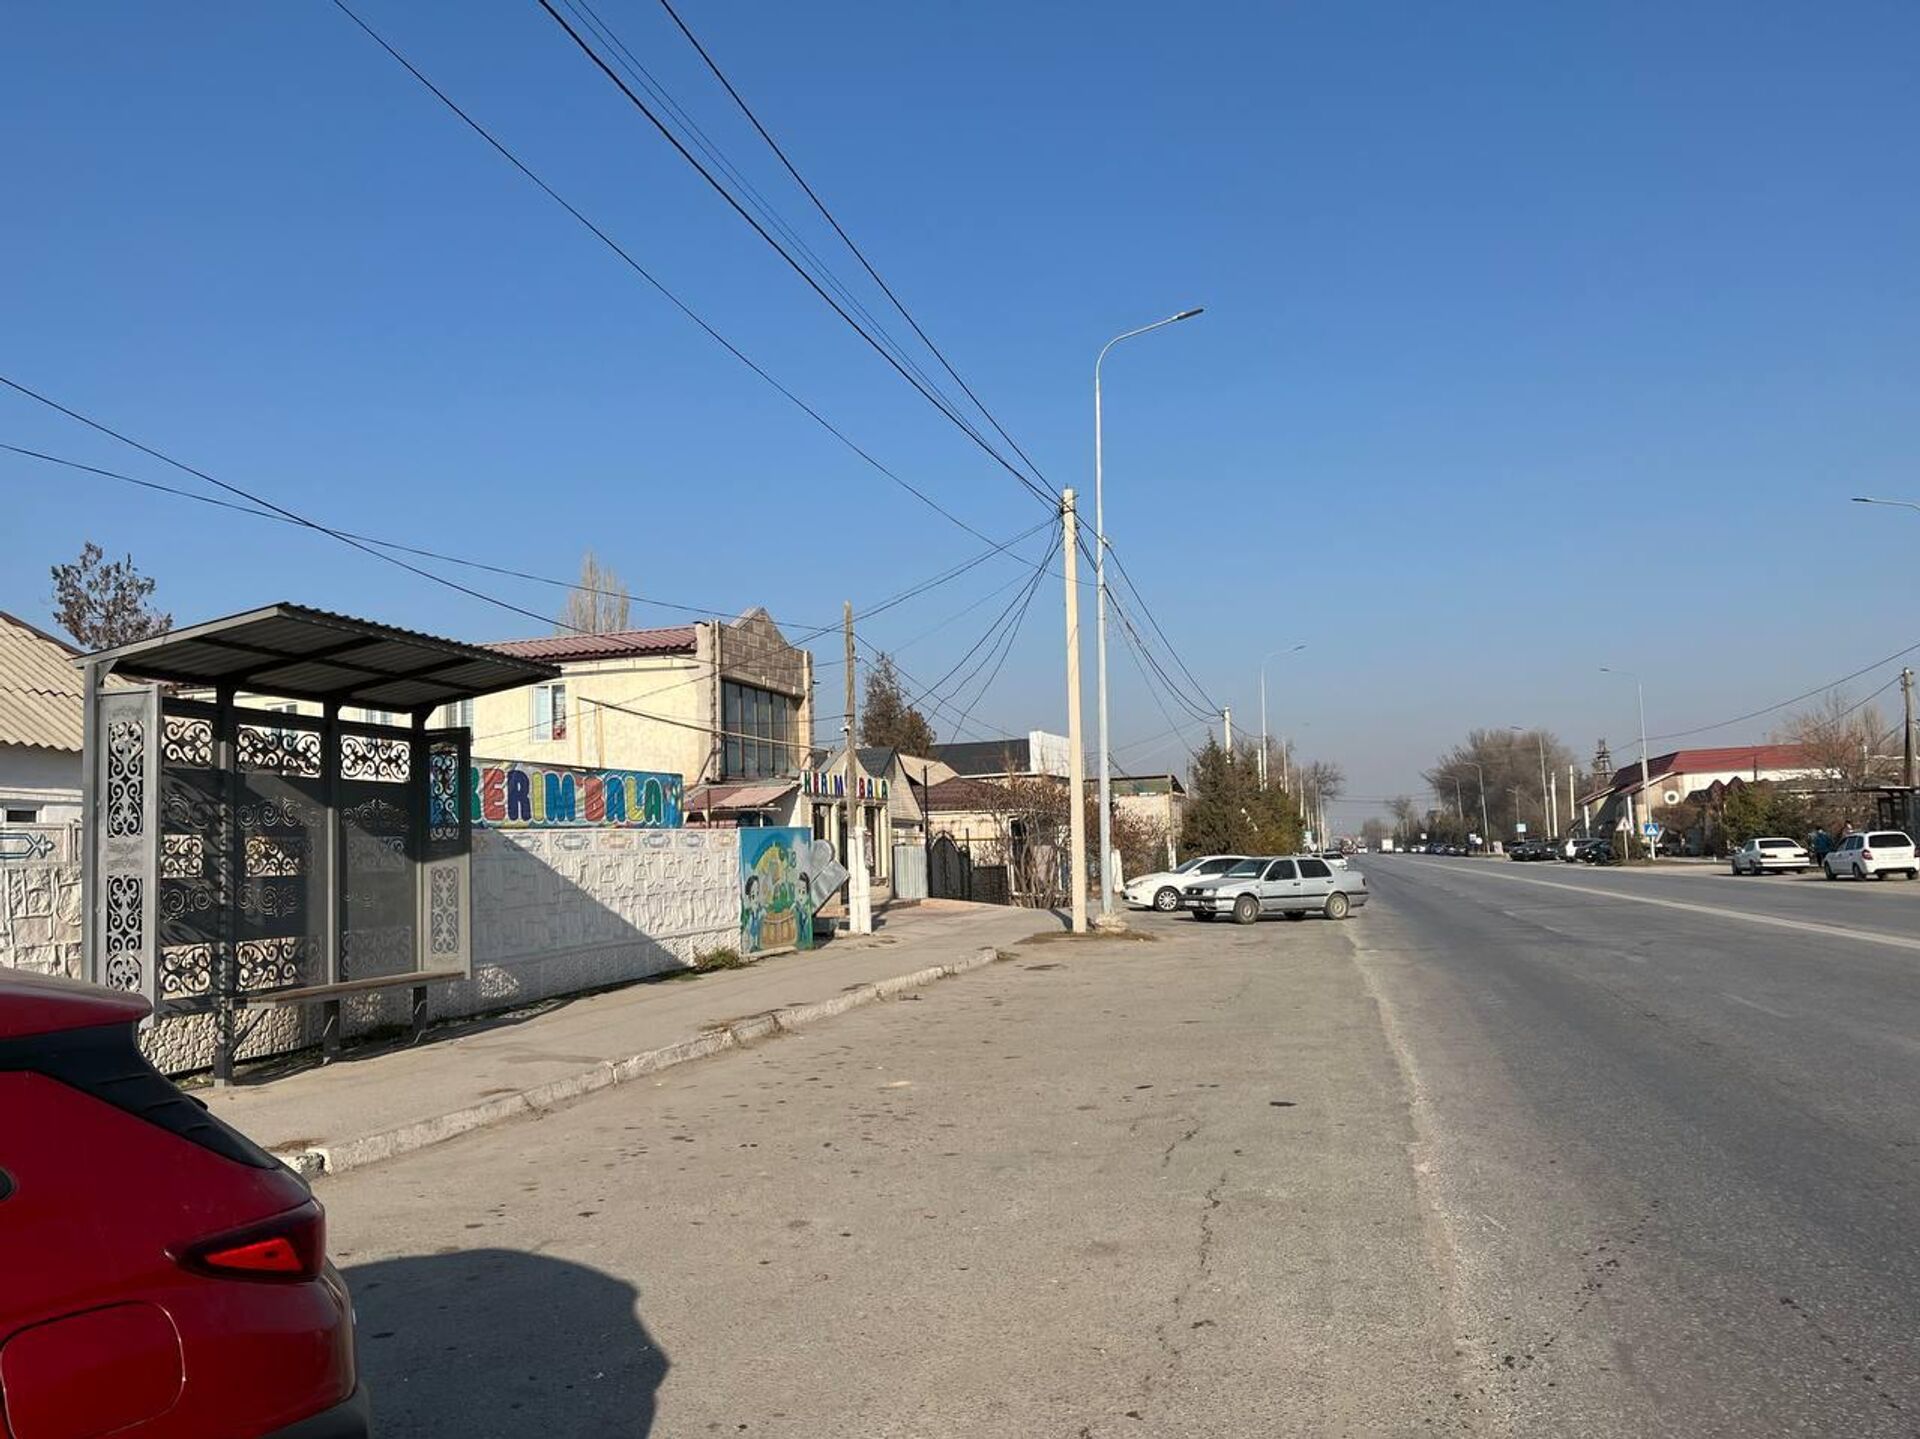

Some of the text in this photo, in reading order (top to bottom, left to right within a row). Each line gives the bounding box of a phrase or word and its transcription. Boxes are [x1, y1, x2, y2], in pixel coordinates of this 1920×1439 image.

[583, 775, 663, 824] BALA
[804, 770, 889, 800] KERIM BALA
